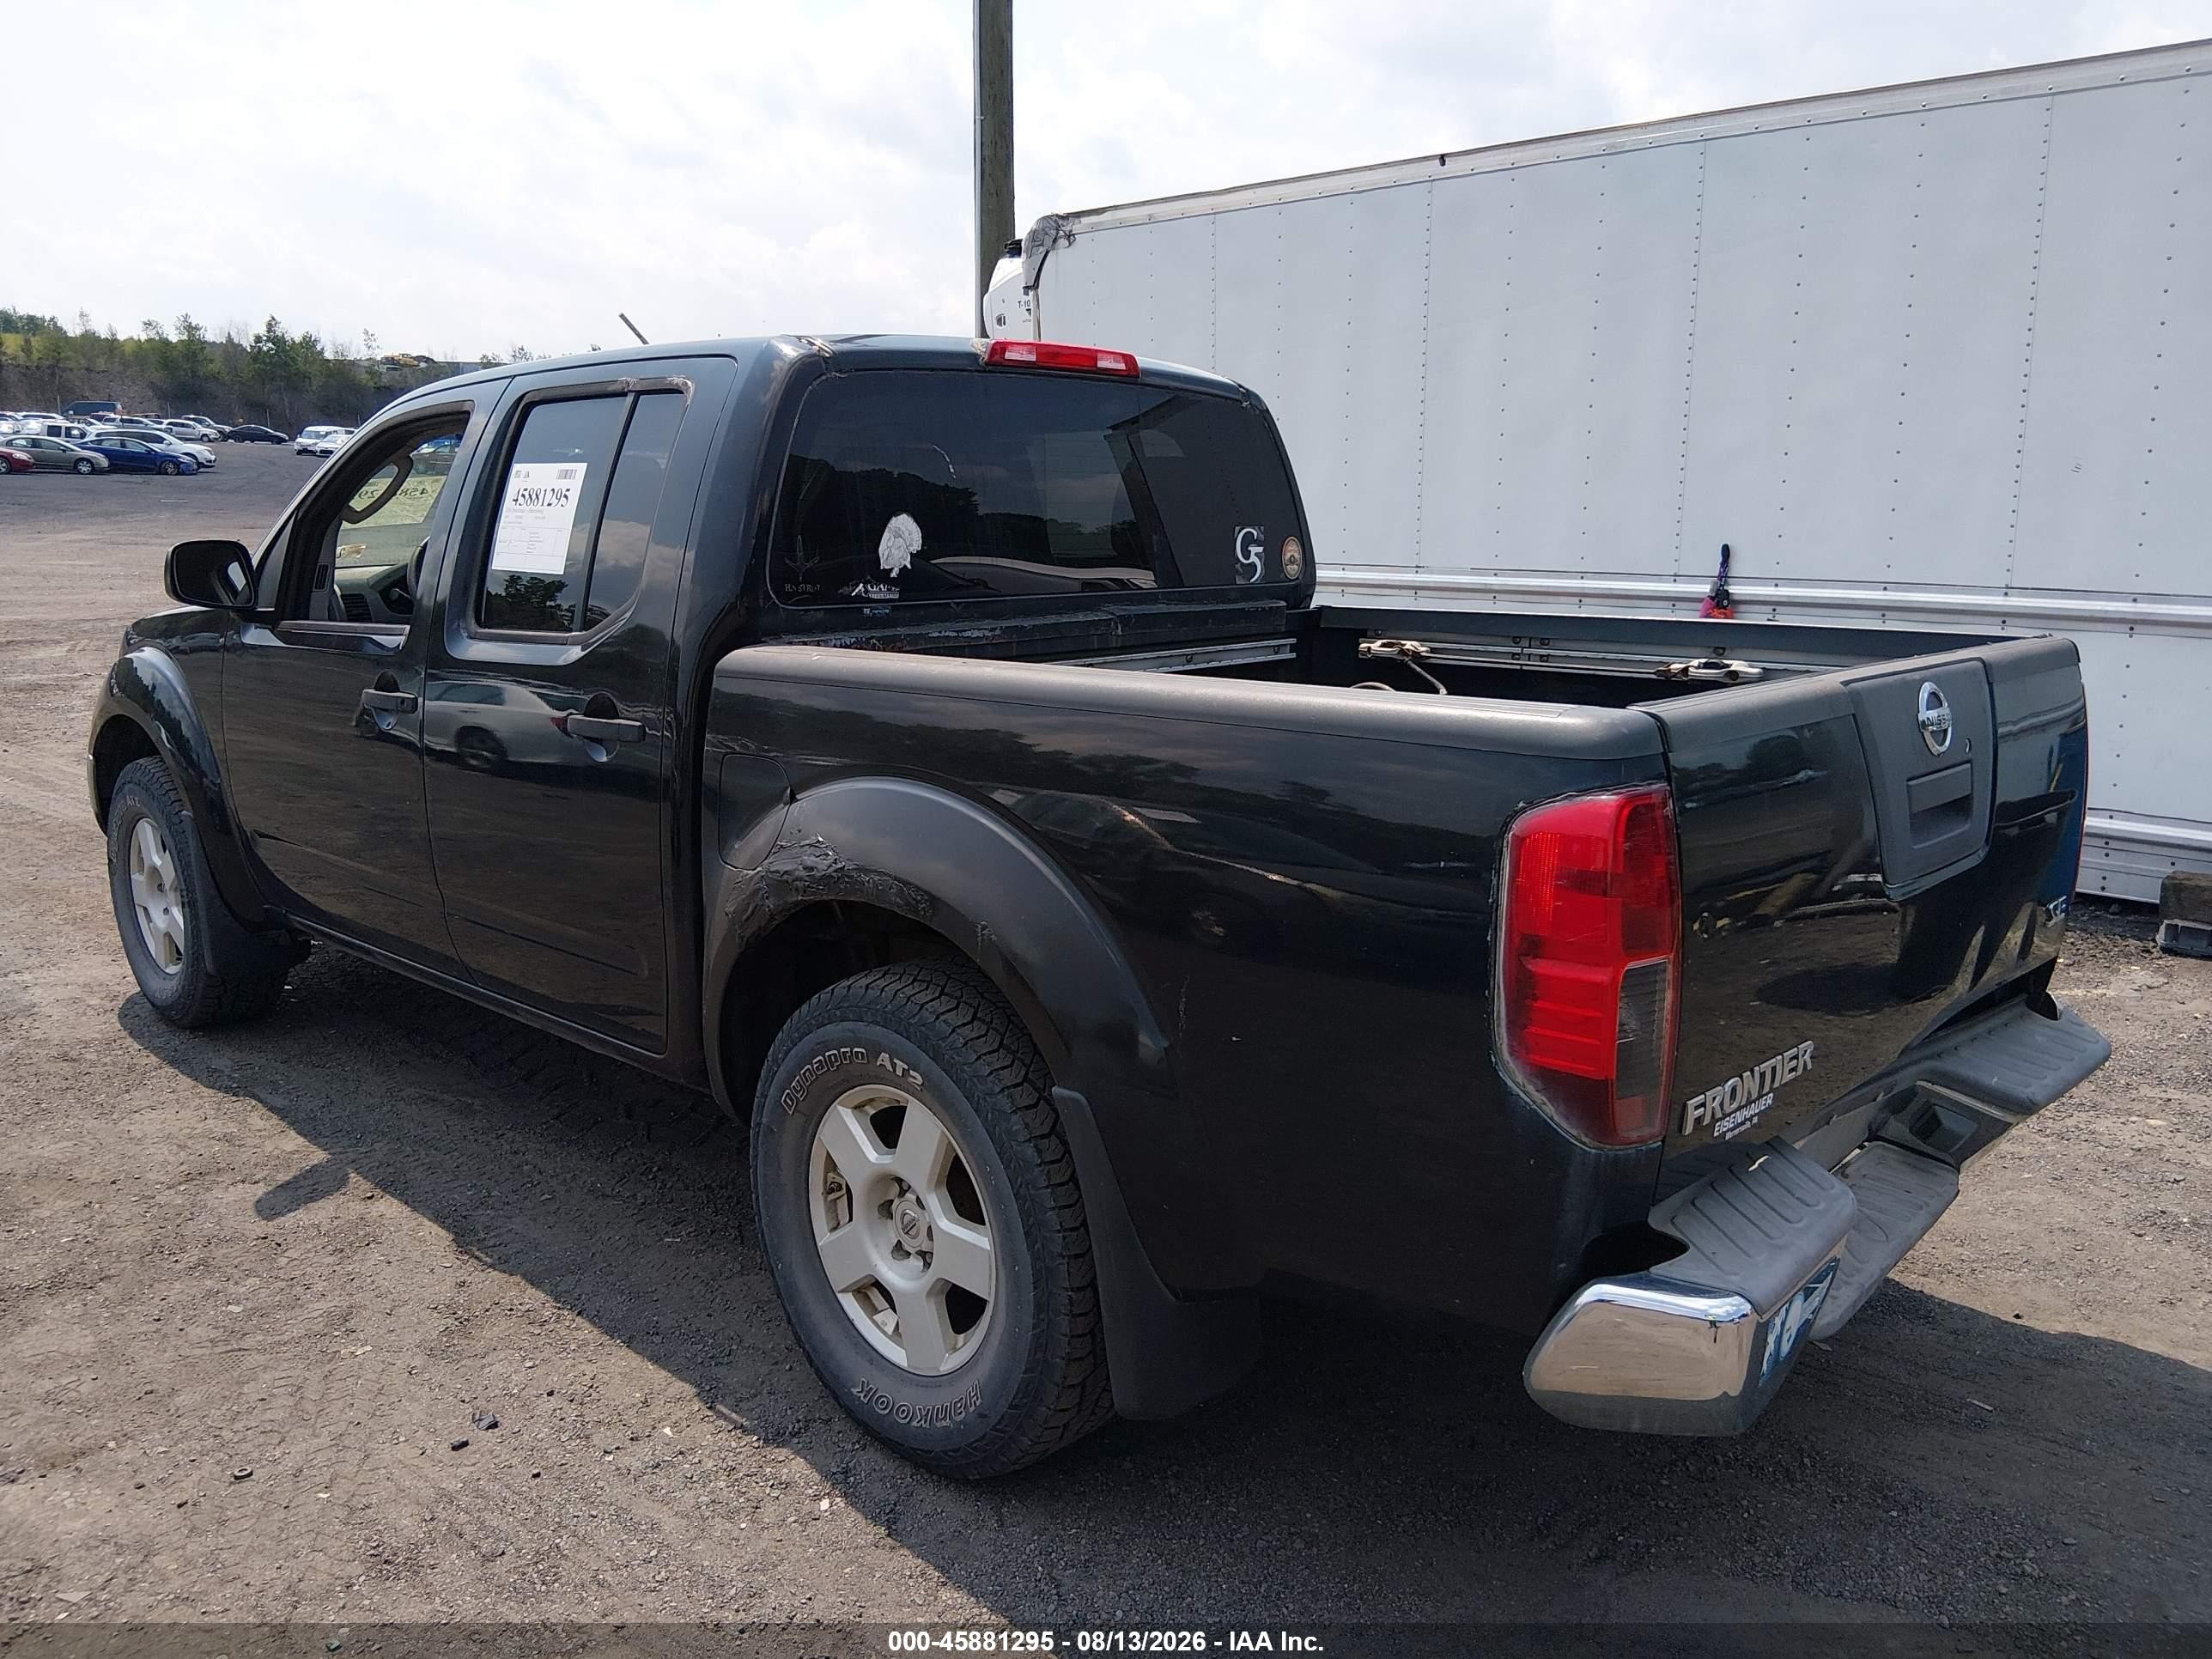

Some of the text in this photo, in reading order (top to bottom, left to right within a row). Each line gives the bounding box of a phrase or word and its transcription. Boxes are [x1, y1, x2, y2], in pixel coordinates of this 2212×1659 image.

[513, 488, 570, 507] 45881295
[781, 1048, 867, 1115] Dynapro
[1681, 1040, 1814, 1136] FRONTIER
[1713, 1092, 1774, 1137] EISENHAUER
[851, 1377, 982, 1428] Hankook
